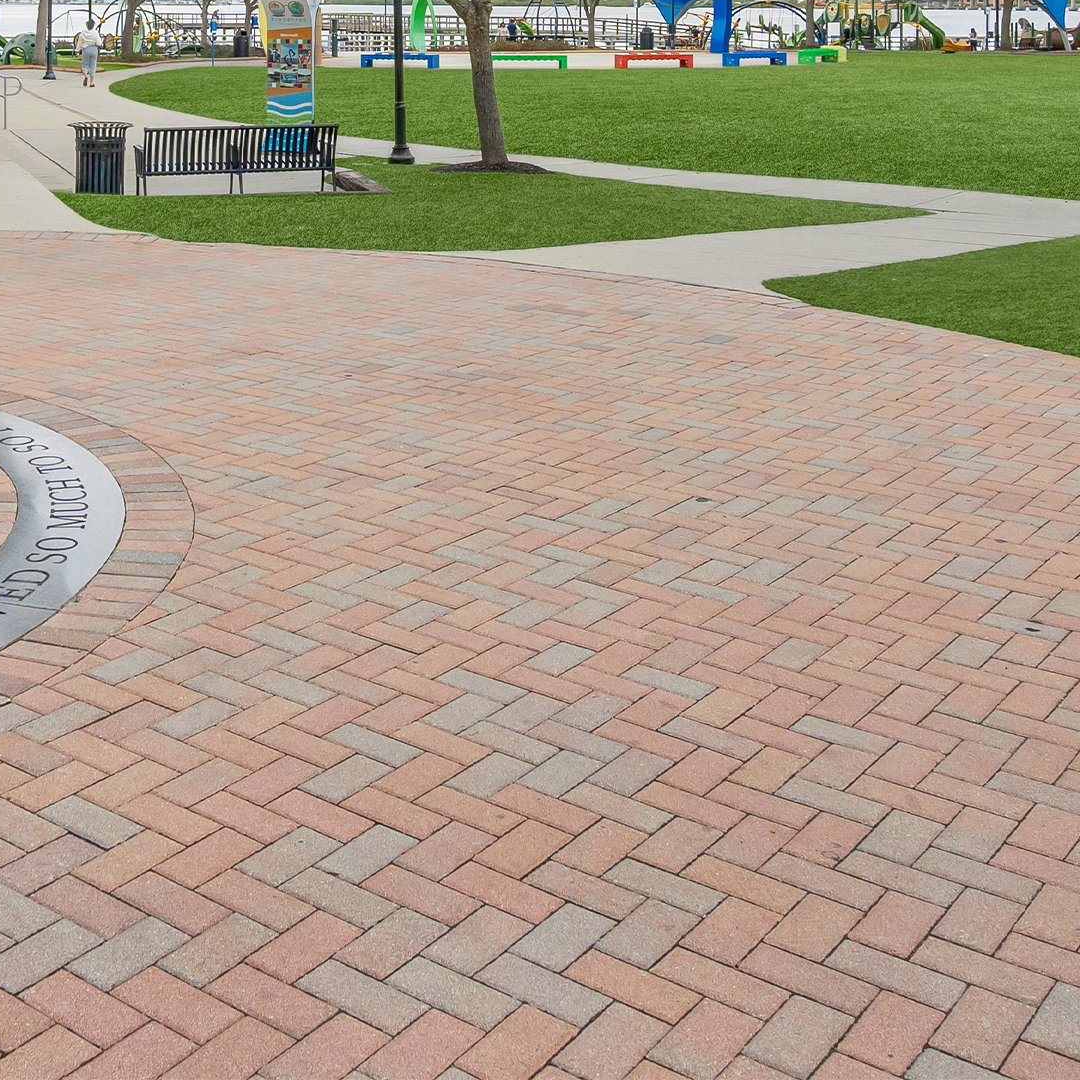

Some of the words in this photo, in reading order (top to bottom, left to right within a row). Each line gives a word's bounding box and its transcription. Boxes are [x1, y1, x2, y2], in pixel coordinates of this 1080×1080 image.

[0, 435, 48, 453] SO
[28, 455, 72, 479] TO
[46, 477, 89, 530] MUCH
[26, 536, 79, 565] SO
